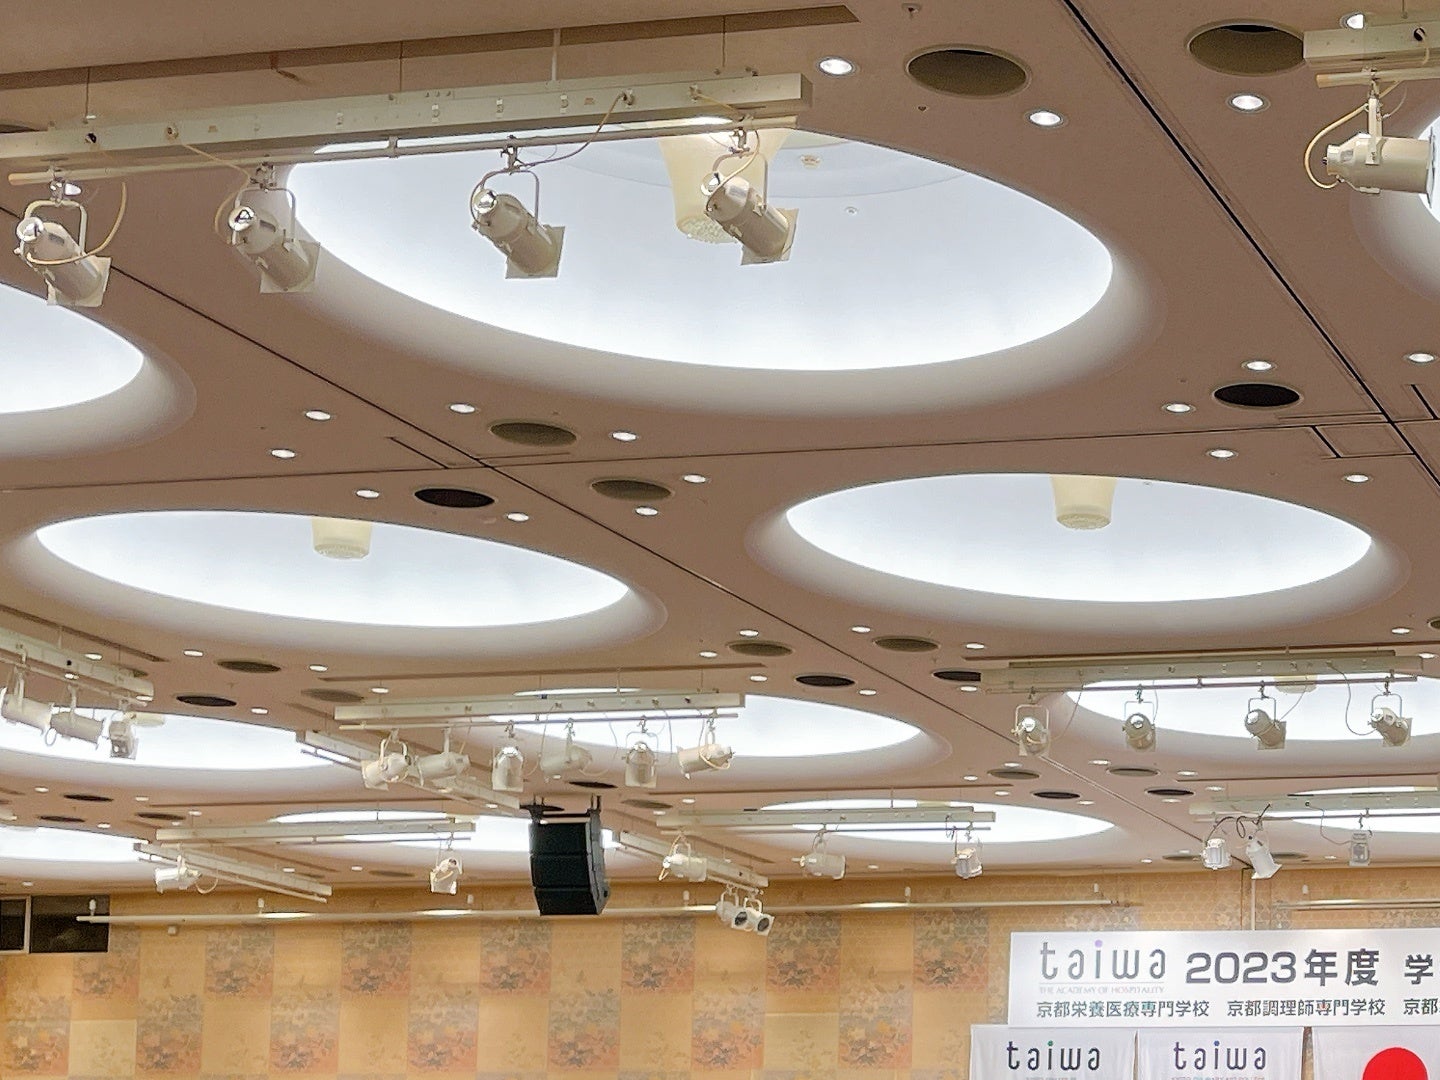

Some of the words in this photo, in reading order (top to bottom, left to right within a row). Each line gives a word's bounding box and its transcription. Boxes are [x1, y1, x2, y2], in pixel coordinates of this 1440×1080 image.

[1040, 939, 1166, 980] taiwa
[1185, 948, 1380, 987] 2023年度
[1036, 1000, 1210, 1018] 京都栄養医療専門学校
[1227, 998, 1386, 1017] 京都調理師専門学校
[1006, 1040, 1100, 1071] taiwa
[1173, 1040, 1266, 1070] taiwa
